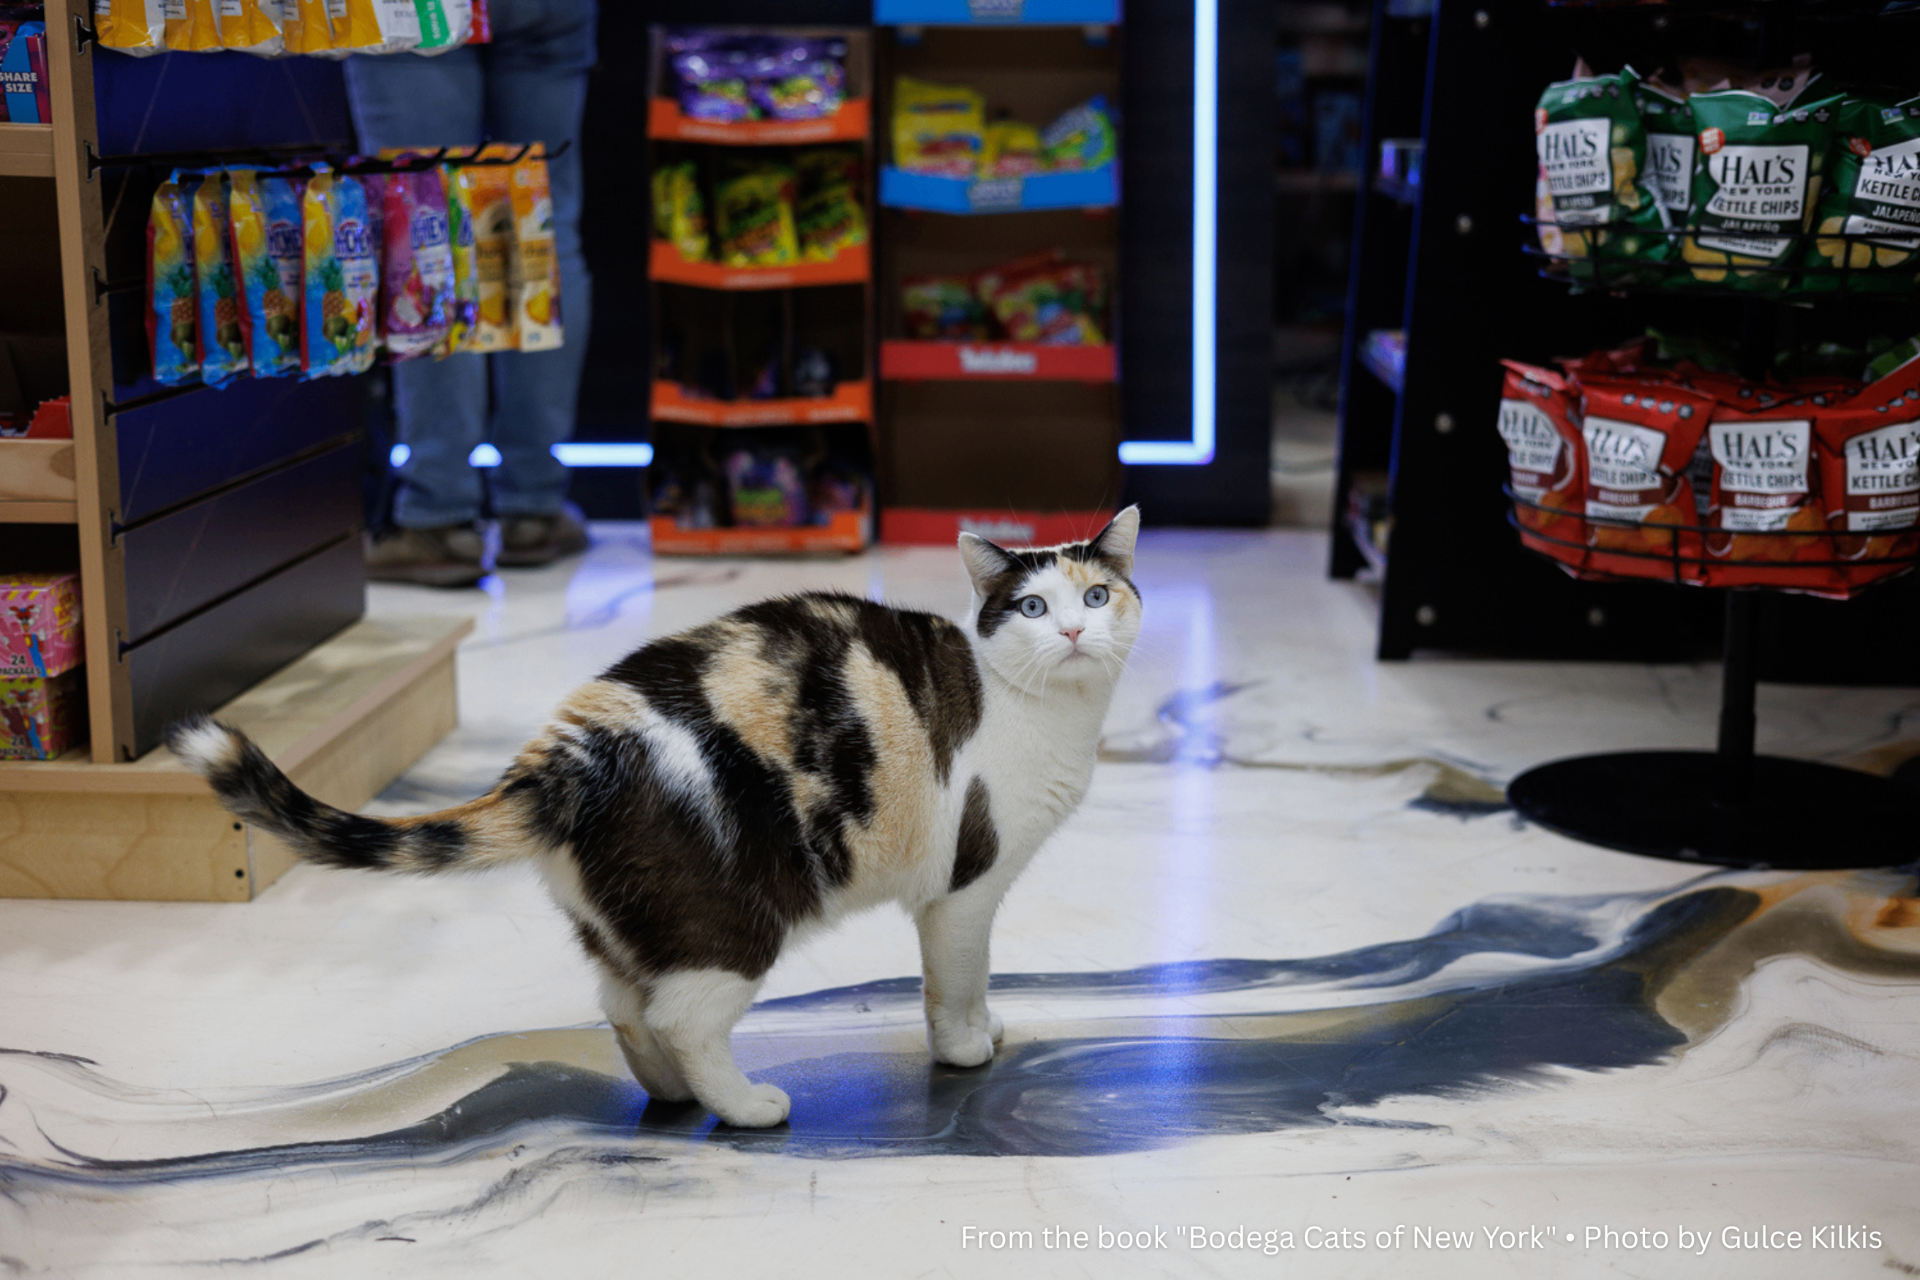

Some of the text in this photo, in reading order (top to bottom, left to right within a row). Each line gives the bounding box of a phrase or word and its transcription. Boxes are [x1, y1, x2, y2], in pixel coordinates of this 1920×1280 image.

[0, 72, 38, 82] SHARE
[5, 83, 33, 93] SIZE
[1545, 129, 1598, 160] HAL'S
[1651, 143, 1682, 174] AL'S
[1721, 155, 1796, 185] HAL'S
[1757, 187, 1791, 196] YORK
[1861, 179, 1908, 199] KETTLE
[1761, 201, 1800, 215] CHIPS
[1723, 429, 1798, 459] HAL'S
[1767, 473, 1804, 488] CHIPS
[1852, 473, 1901, 490] KETTLE
[1734, 493, 1788, 508] BARBEQUE
[10, 654, 26, 666] 24
